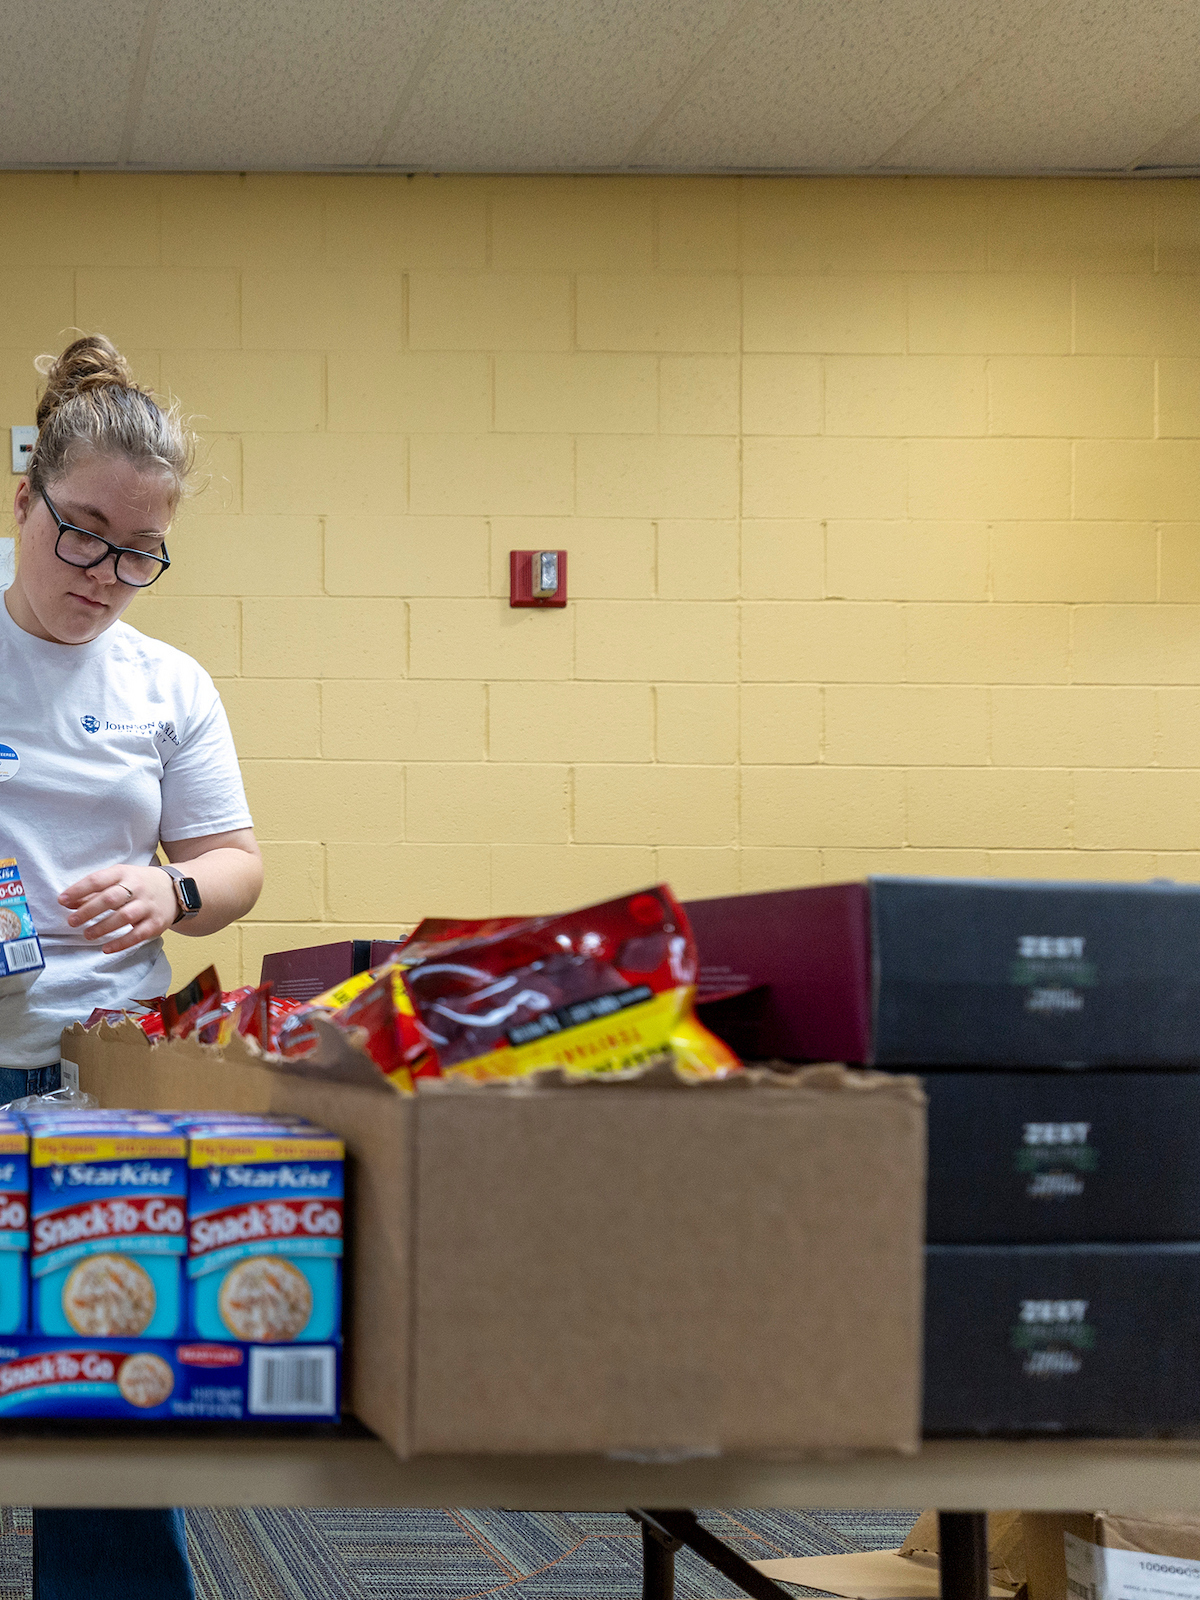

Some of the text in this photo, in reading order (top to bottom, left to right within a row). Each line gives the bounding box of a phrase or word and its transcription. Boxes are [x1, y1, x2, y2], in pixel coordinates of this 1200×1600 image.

[105, 721, 155, 731] JOHNSON
[68, 1163, 173, 1185] StarKist
[225, 1165, 331, 1188] StarKist
